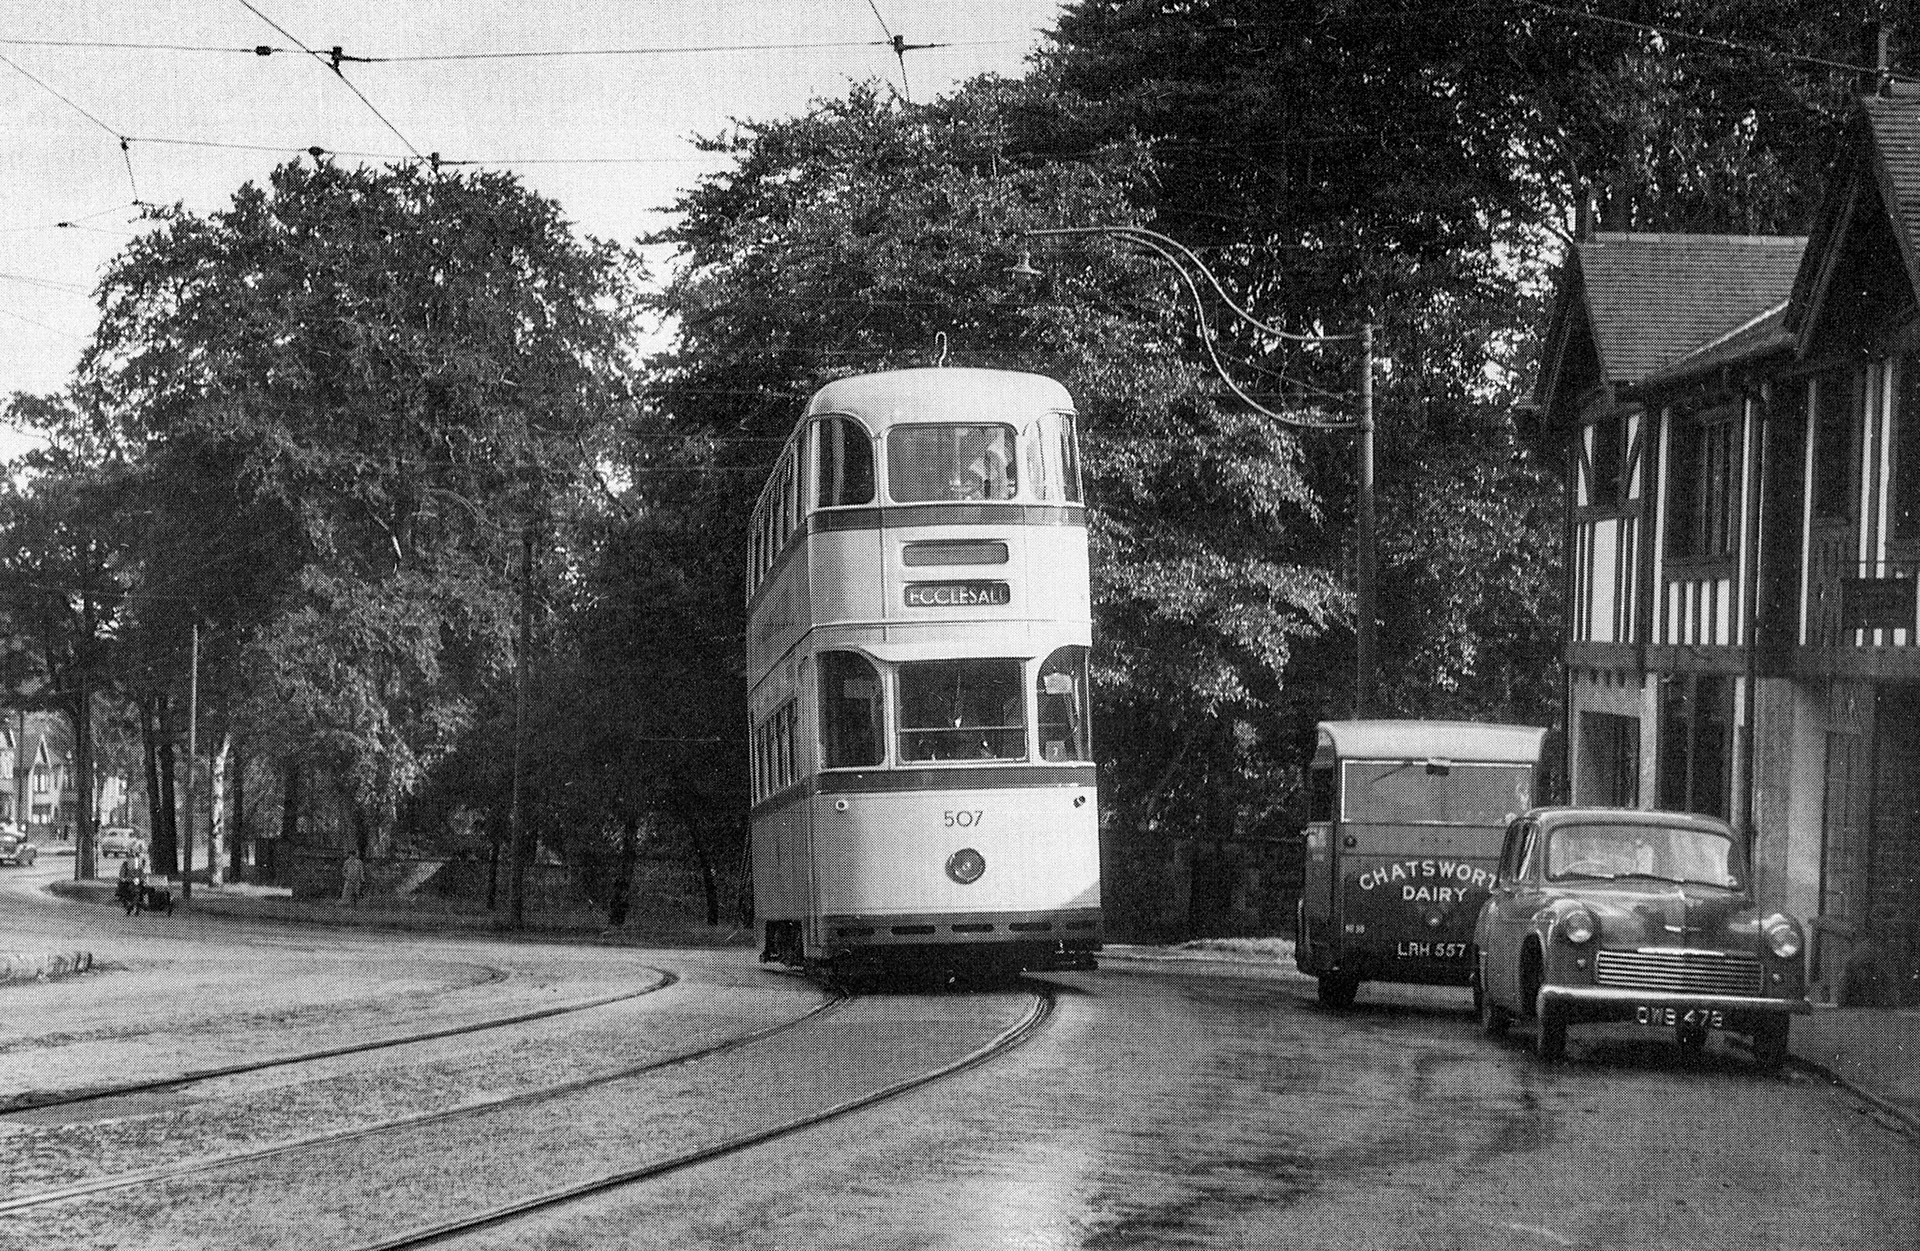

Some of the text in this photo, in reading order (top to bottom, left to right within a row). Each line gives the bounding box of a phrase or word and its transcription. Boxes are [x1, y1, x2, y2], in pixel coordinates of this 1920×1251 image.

[910, 585, 1005, 604] ECCLESALL
[944, 810, 983, 827] 507
[1360, 860, 1498, 891] CHATSWORT
[1403, 885, 1468, 902] DAIRY
[1397, 942, 1466, 957] LRH 557
